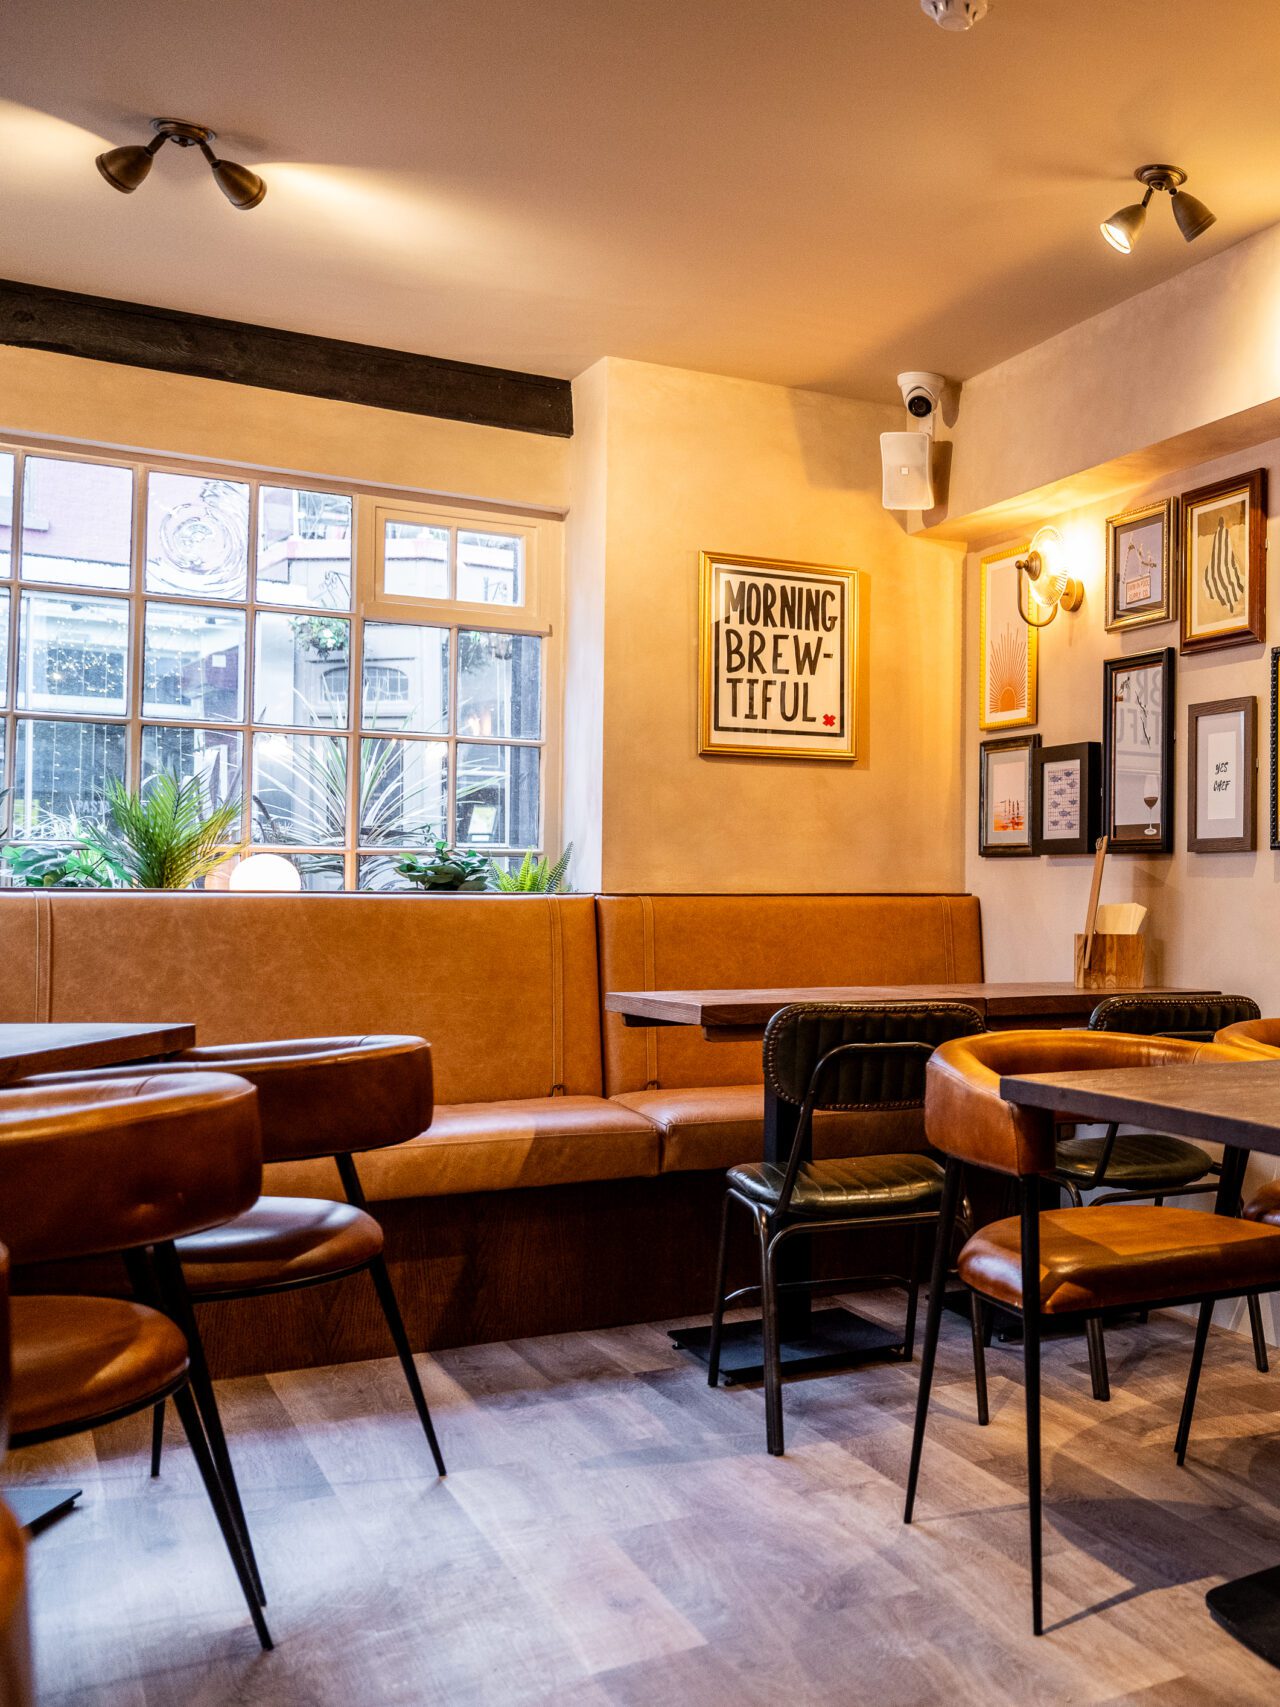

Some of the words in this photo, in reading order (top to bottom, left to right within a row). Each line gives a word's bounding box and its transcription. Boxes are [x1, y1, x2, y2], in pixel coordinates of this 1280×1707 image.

[724, 579, 838, 632] MORNING
[725, 628, 834, 676] BREW-
[1214, 761, 1229, 775] YES
[1213, 780, 1231, 792] CHEF
